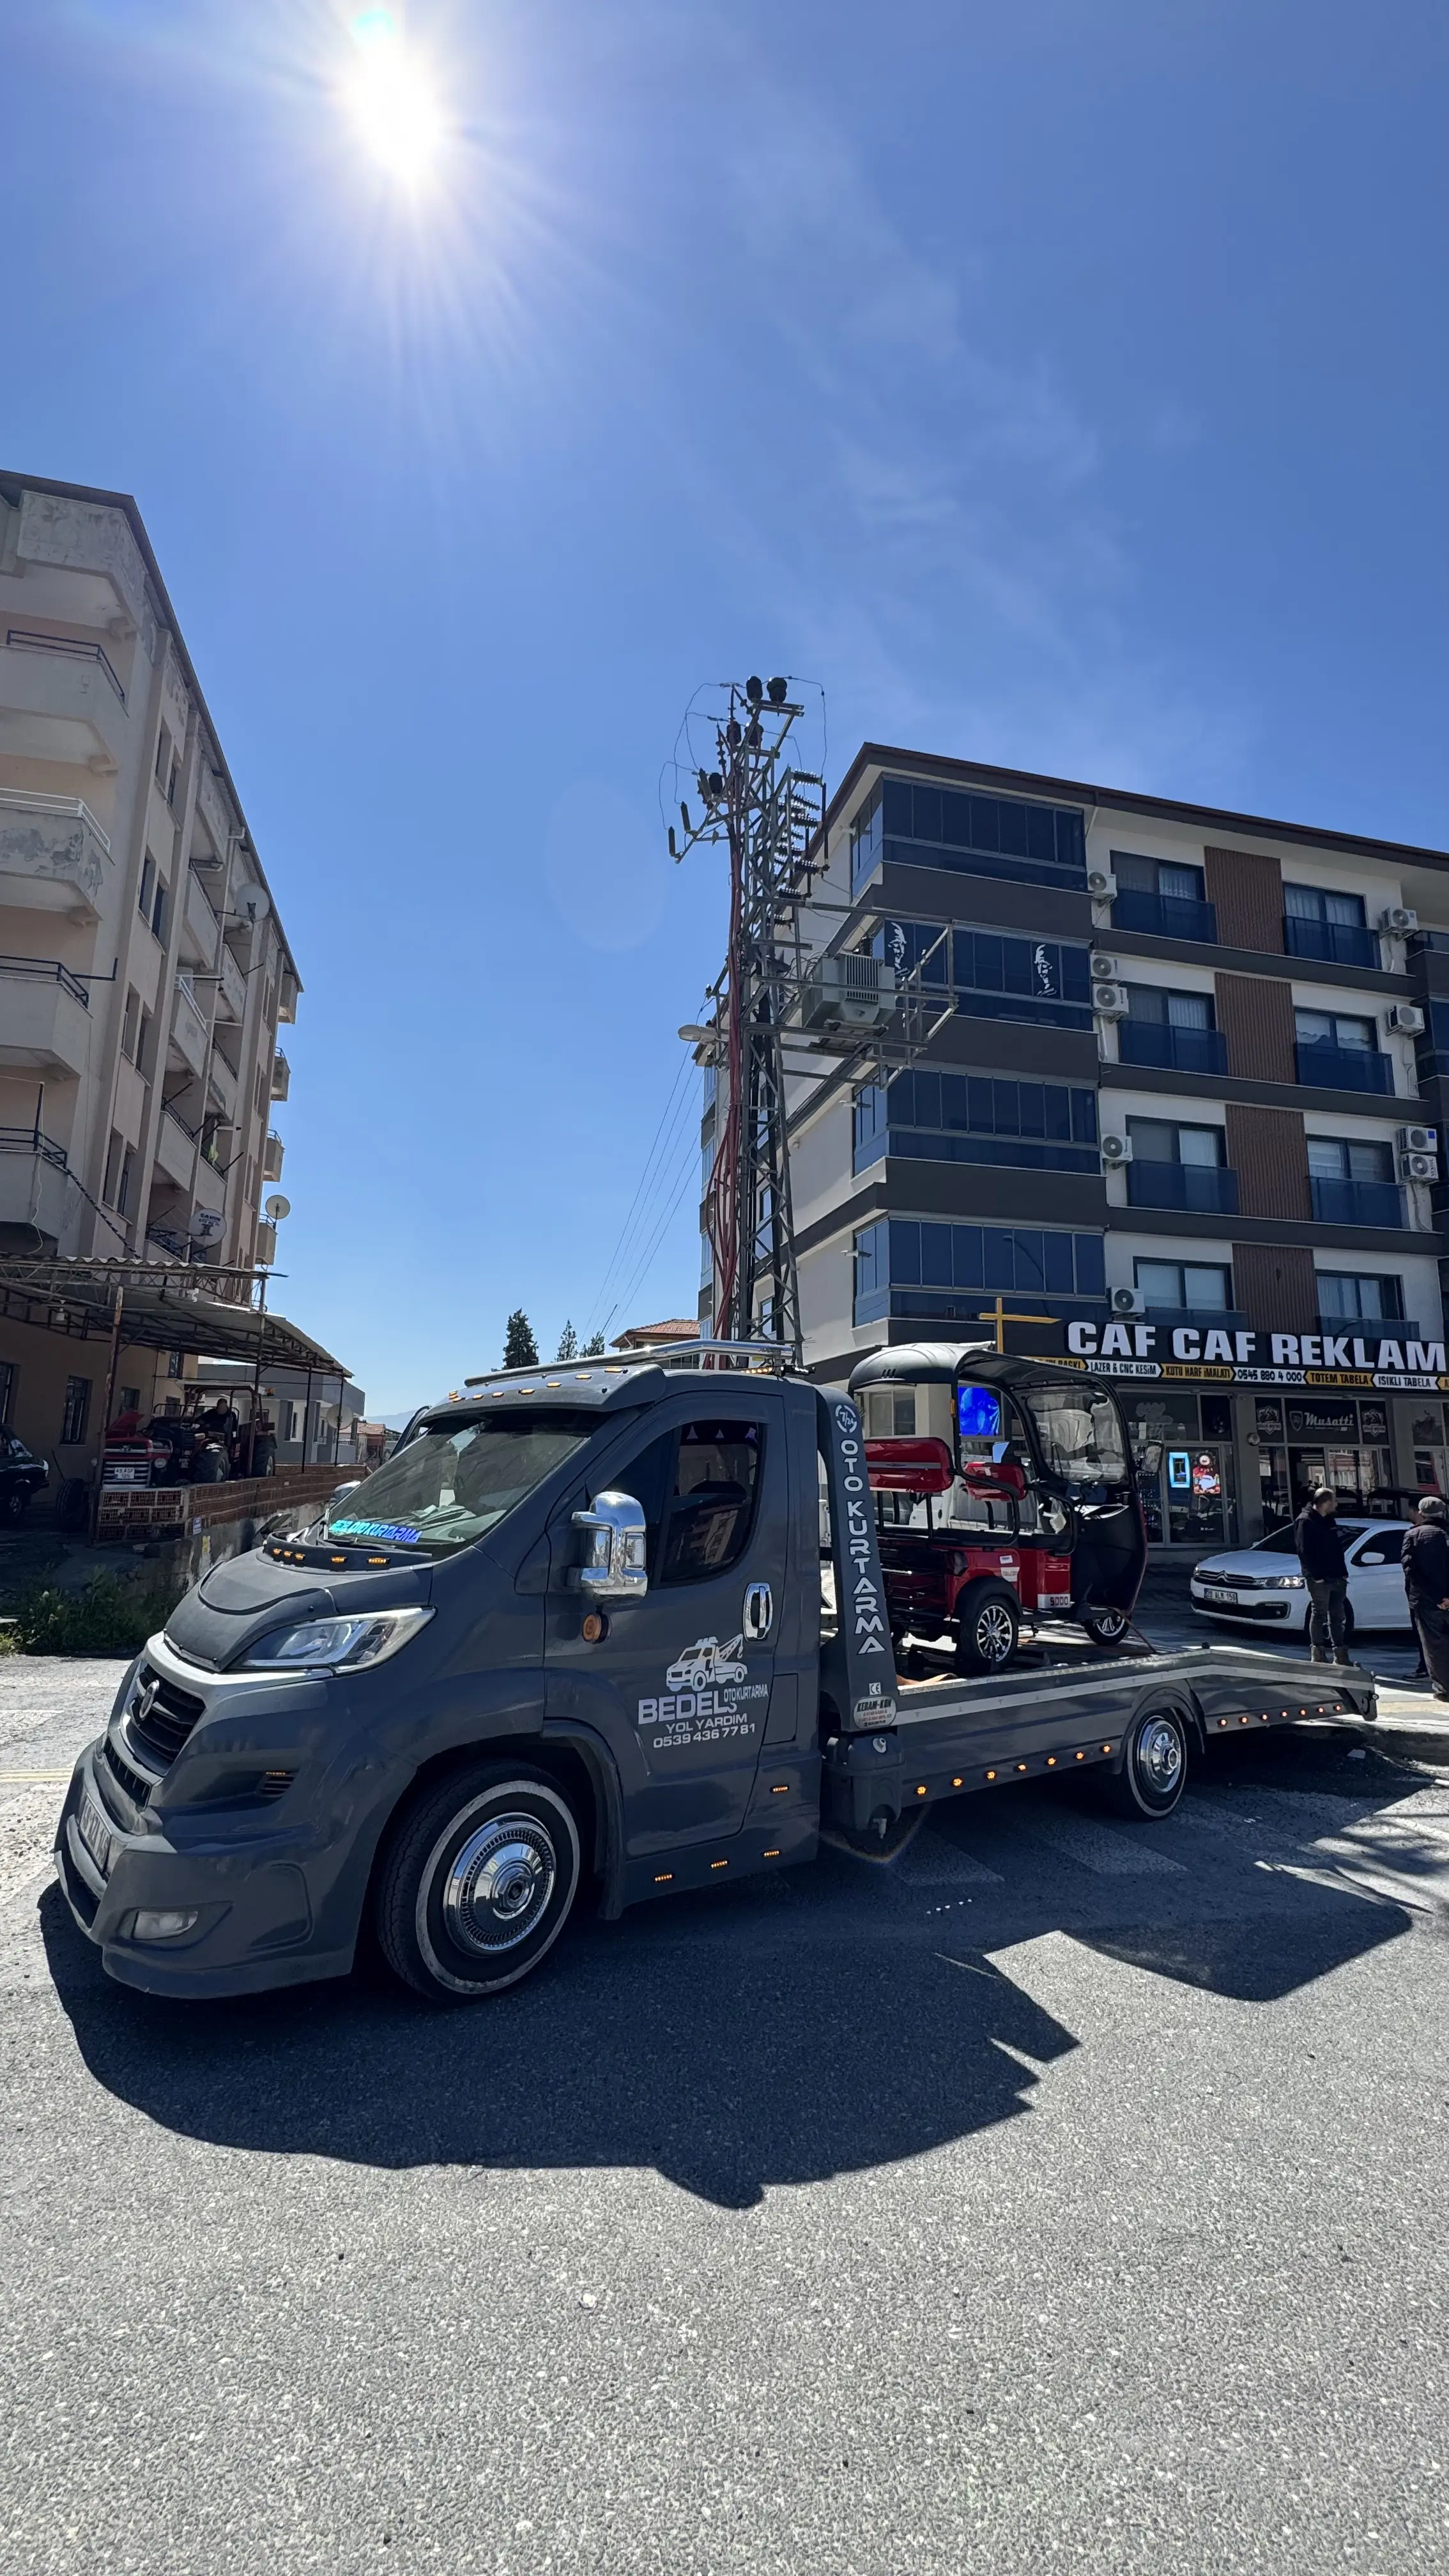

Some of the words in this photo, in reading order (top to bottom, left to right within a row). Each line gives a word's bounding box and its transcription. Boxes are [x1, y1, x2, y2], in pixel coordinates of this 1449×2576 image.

[1068, 1321, 1156, 1357] CAF
[1172, 1328, 1255, 1362] CAF
[1271, 1333, 1447, 1372] REKLAM
[1091, 1361, 1111, 1373] LAZER
[1113, 1363, 1118, 1373] &
[1119, 1363, 1134, 1374] CNC
[1165, 1365, 1182, 1377] KUTU
[1184, 1366, 1202, 1377] HARF
[1238, 1368, 1258, 1380] 0545
[1278, 1371, 1284, 1381] 4
[1286, 1372, 1302, 1382] 000
[1310, 1372, 1338, 1384] TOTEM
[1340, 1373, 1369, 1384] TABELA
[1403, 1377, 1431, 1388] TABELA
[839, 1411, 854, 1427] 7/24
[1304, 1412, 1354, 1426] Musatti
[841, 1439, 863, 1492] OTO
[366, 1522, 423, 1544] KURTARMA
[847, 1500, 886, 1655] KURTARMA
[666, 1721, 693, 1734] YOL
[696, 1713, 747, 1729] YARDIM
[653, 1733, 691, 1748] 0539
[693, 1728, 719, 1742] 436
